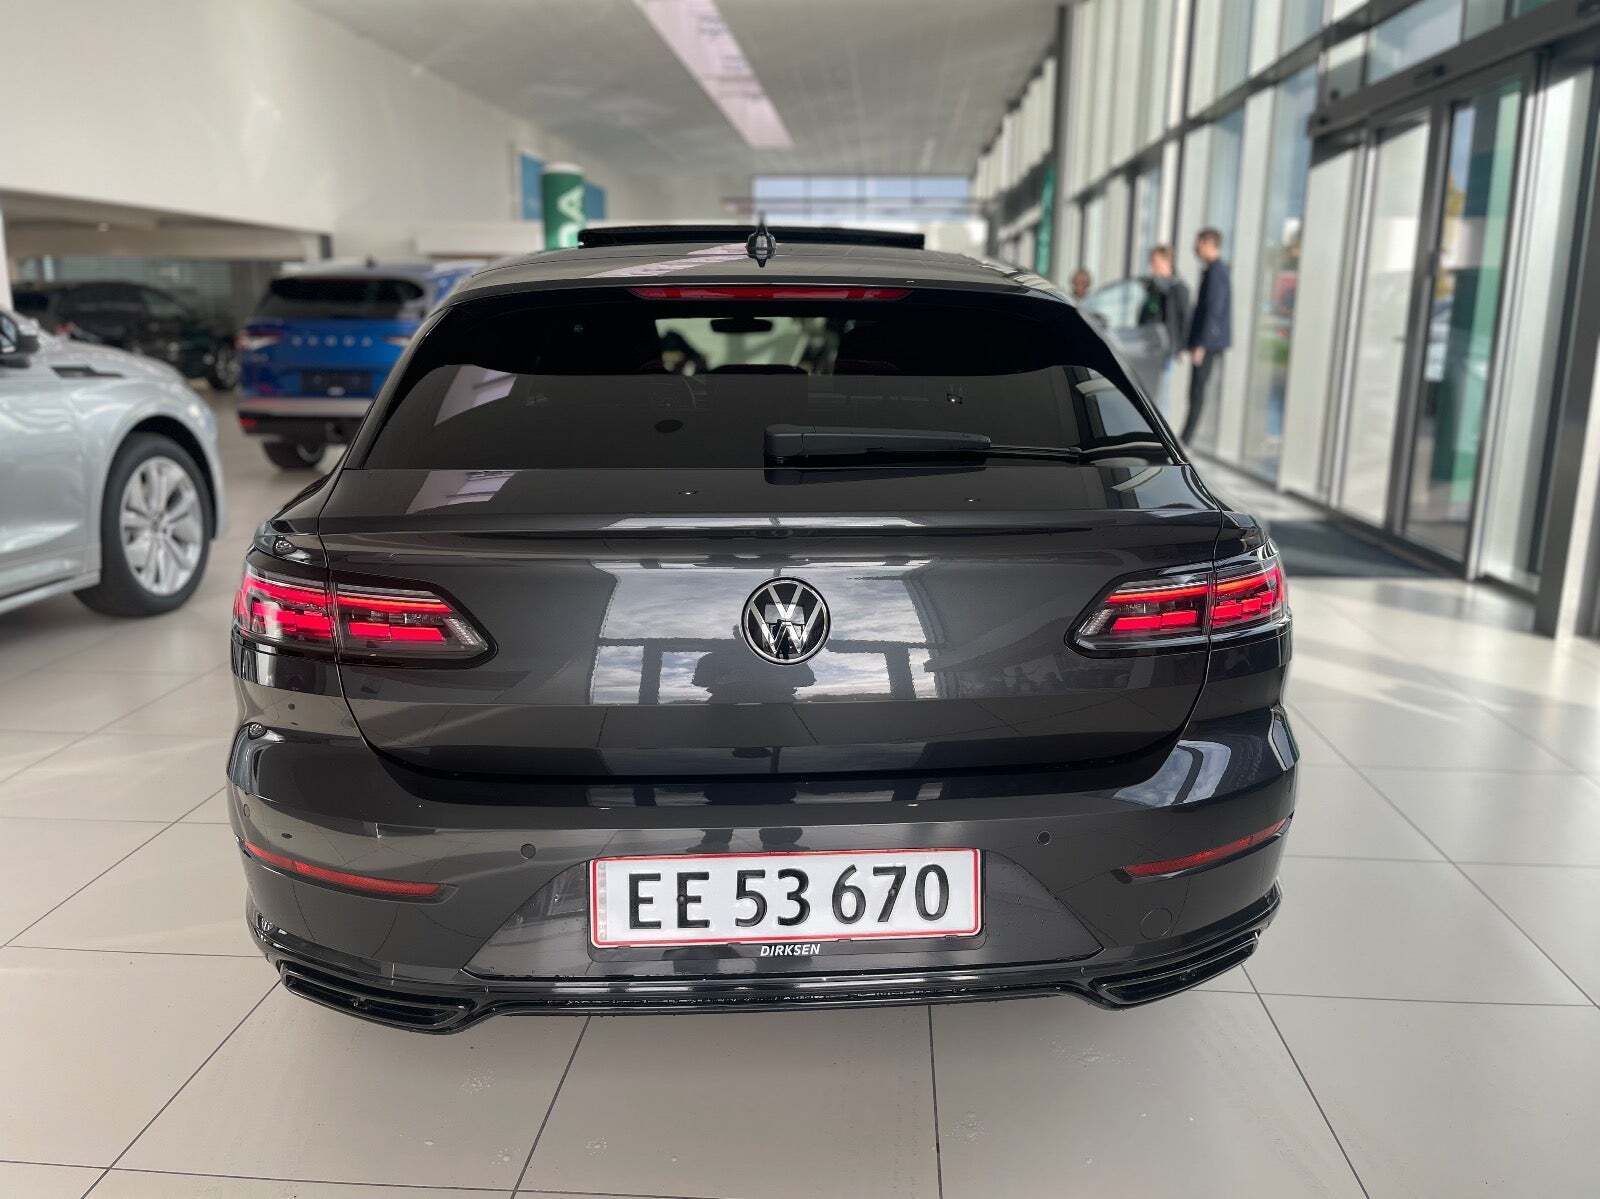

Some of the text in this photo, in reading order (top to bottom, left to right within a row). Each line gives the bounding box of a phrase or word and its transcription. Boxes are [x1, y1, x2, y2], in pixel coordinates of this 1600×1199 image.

[629, 872, 711, 929] EE
[735, 868, 811, 928] 53
[832, 864, 950, 925] 670
[760, 943, 821, 957] DIRKSEN
